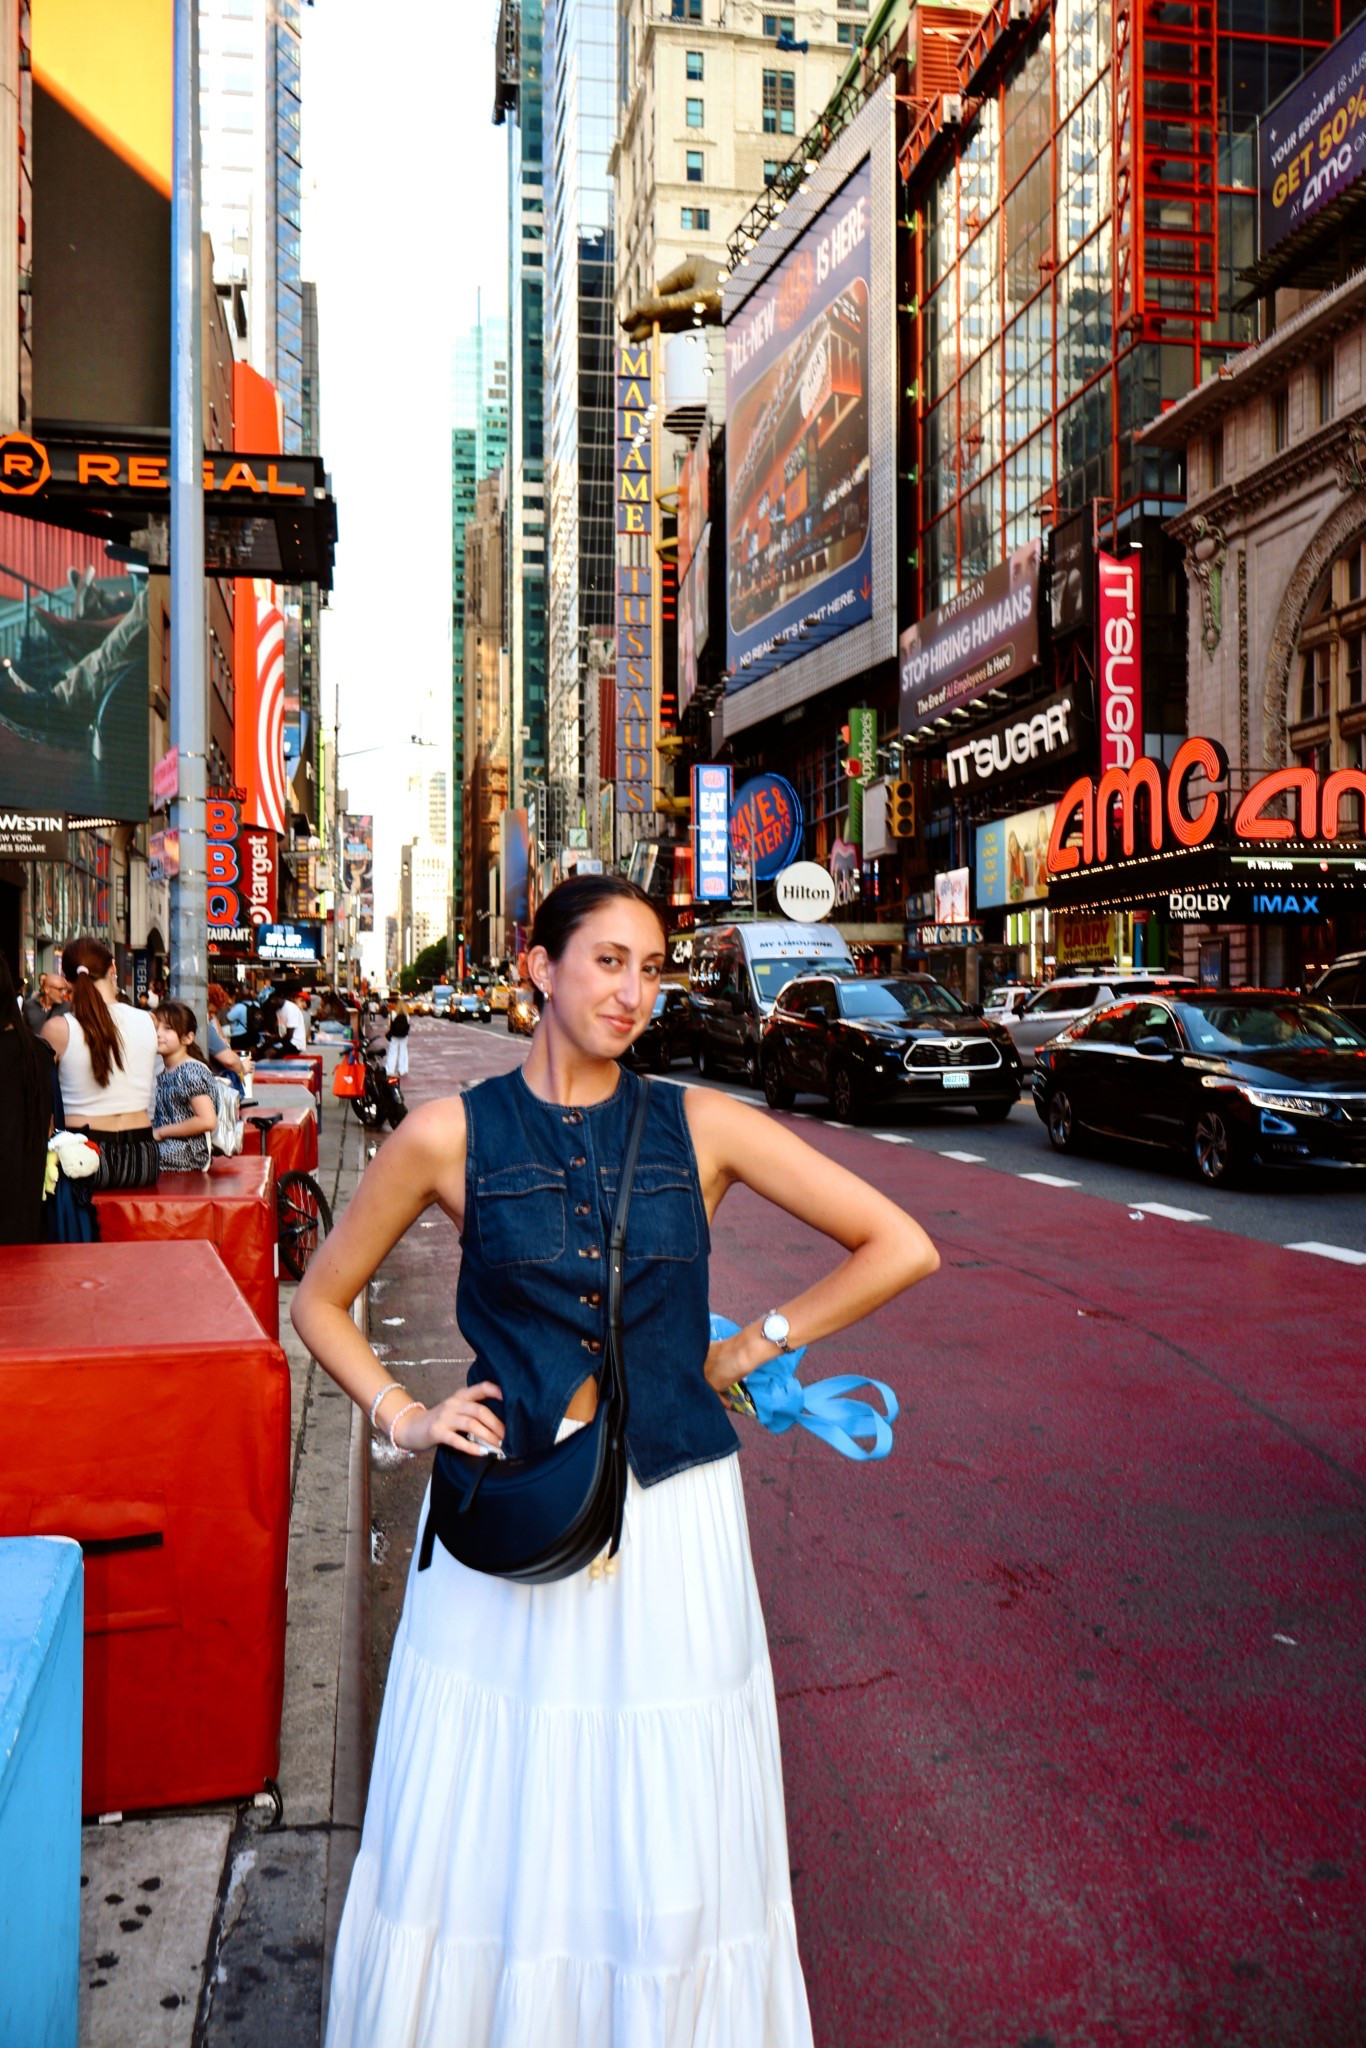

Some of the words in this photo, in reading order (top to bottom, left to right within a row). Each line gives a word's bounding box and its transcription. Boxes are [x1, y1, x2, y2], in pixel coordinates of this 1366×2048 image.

[1271, 131, 1297, 168] YOUR
[1298, 86, 1336, 139] ESCAPE
[1338, 74, 1347, 96] IS
[1272, 141, 1314, 208] GET
[1318, 84, 1366, 161] 50%
[729, 297, 776, 378] ALL-NEW
[816, 236, 830, 285] IS
[831, 195, 867, 271] HERE
[620, 350, 649, 534] MADAME
[943, 580, 985, 621] ARTISAN
[740, 652, 751, 667] NO
[901, 652, 930, 692] STOP
[930, 623, 971, 676] HIRING
[971, 585, 1032, 650] HUMANS
[624, 568, 648, 812] TUSSAUDS
[917, 699, 928, 715] The
[993, 654, 1011, 674] Here
[946, 702, 1068, 788] IT'SUGAR
[0, 814, 62, 831] WESTIN
[11, 834, 32, 842] YORK
[730, 790, 774, 847] DAVE
[771, 786, 788, 815] &
[15, 844, 46, 853] SQUARE
[206, 799, 240, 928] BBQ
[248, 835, 272, 905] target
[783, 884, 830, 900] Hilton
[1169, 893, 1231, 911] DOLBY
[1253, 895, 1319, 914] IMAX
[1169, 910, 1201, 920] CINEMA
[1063, 921, 1110, 948] CANDY
